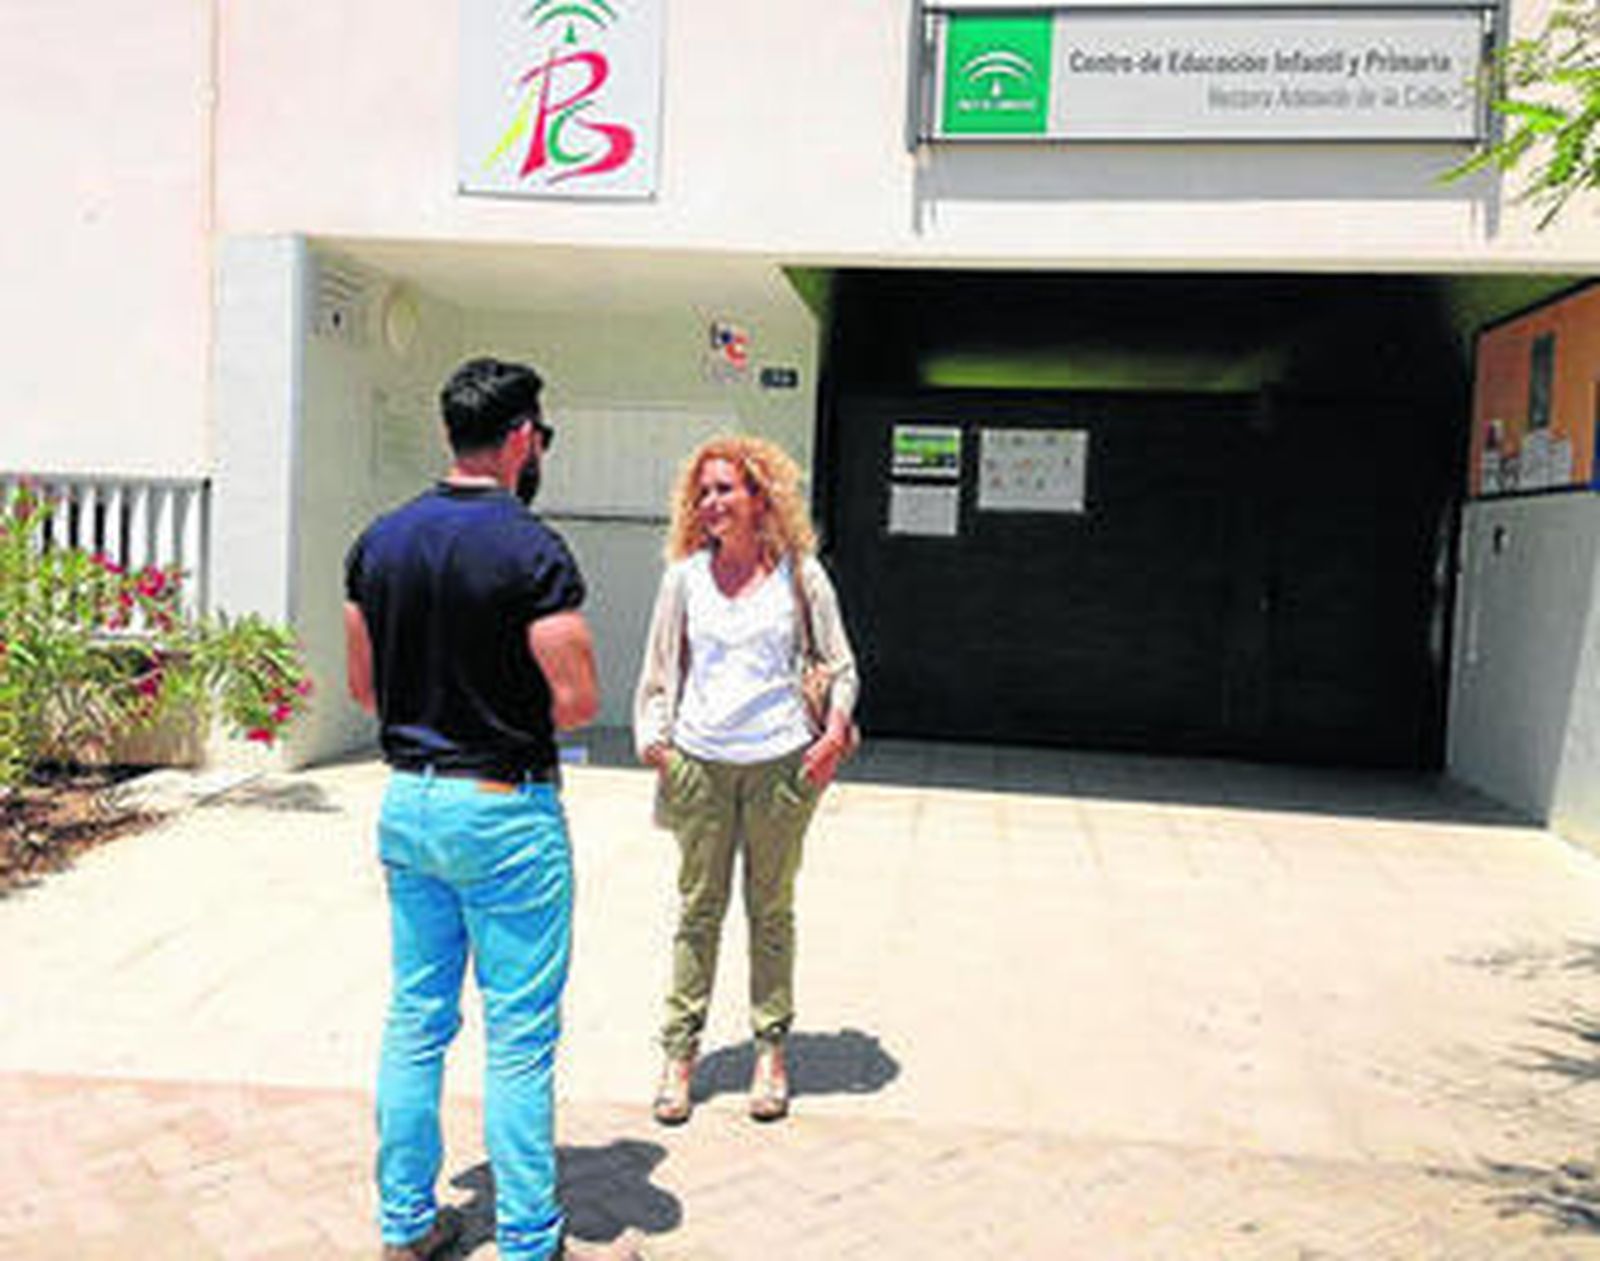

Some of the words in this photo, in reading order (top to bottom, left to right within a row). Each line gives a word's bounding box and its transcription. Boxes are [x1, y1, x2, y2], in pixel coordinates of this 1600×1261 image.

[1069, 50, 1132, 73] Centro
[1139, 51, 1162, 73] de
[1274, 50, 1344, 73] Infantil
[1348, 56, 1360, 77] y
[1365, 48, 1451, 73] Primaria
